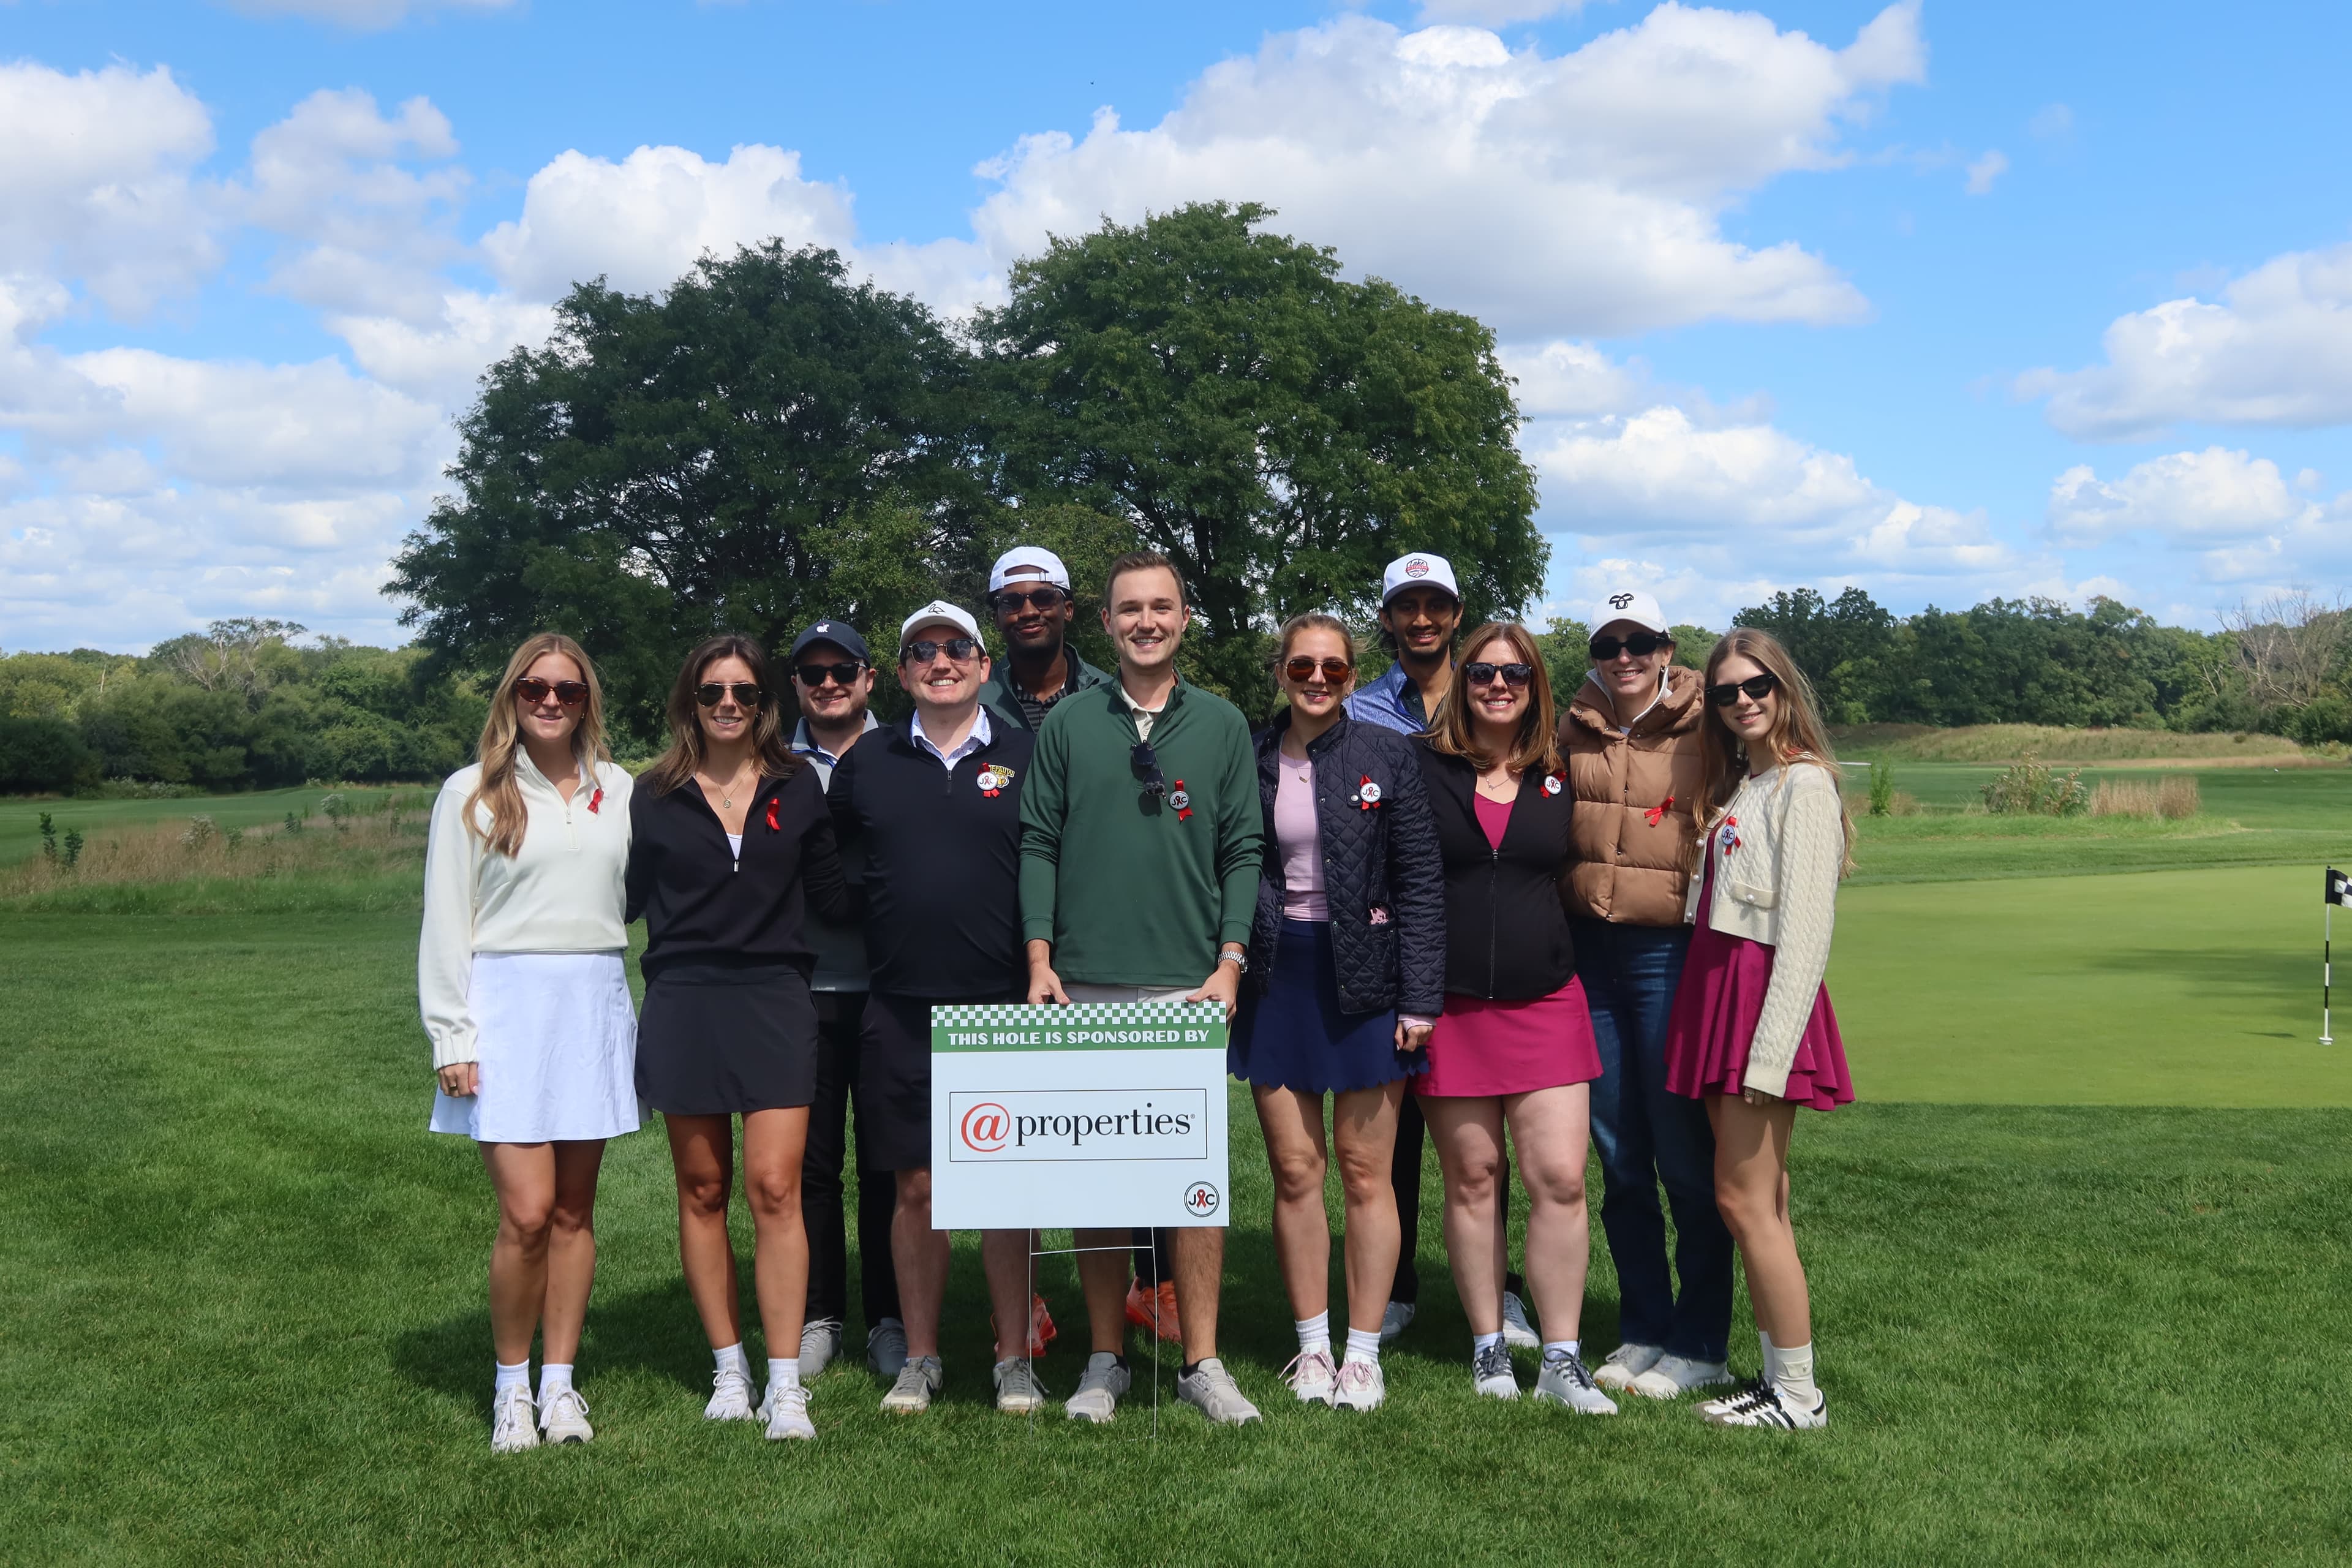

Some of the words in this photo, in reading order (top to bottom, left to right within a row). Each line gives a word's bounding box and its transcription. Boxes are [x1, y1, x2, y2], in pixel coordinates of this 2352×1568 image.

[948, 1033, 988, 1045] THIS
[992, 1032, 1041, 1045] HOLE
[1046, 1031, 1062, 1044] IS
[1067, 1030, 1180, 1044] SPONSORED
[1185, 1030, 1209, 1042] BY
